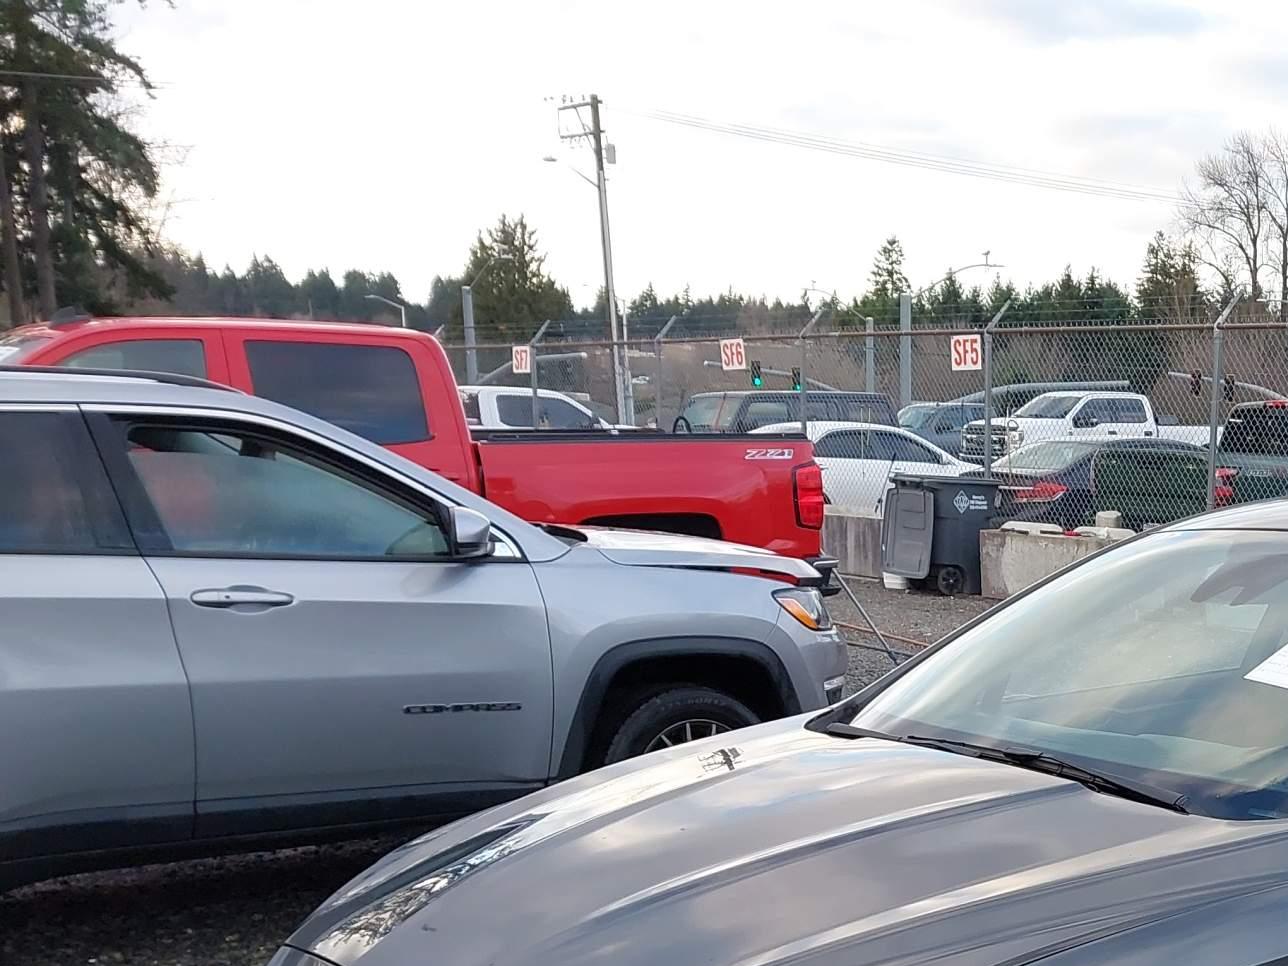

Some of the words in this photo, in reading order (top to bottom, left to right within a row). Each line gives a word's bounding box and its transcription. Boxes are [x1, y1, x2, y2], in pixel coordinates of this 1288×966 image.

[514, 349, 528, 370] SF7
[722, 342, 743, 367] SF6
[953, 338, 978, 366] SF5
[402, 702, 522, 714] COMPASS
